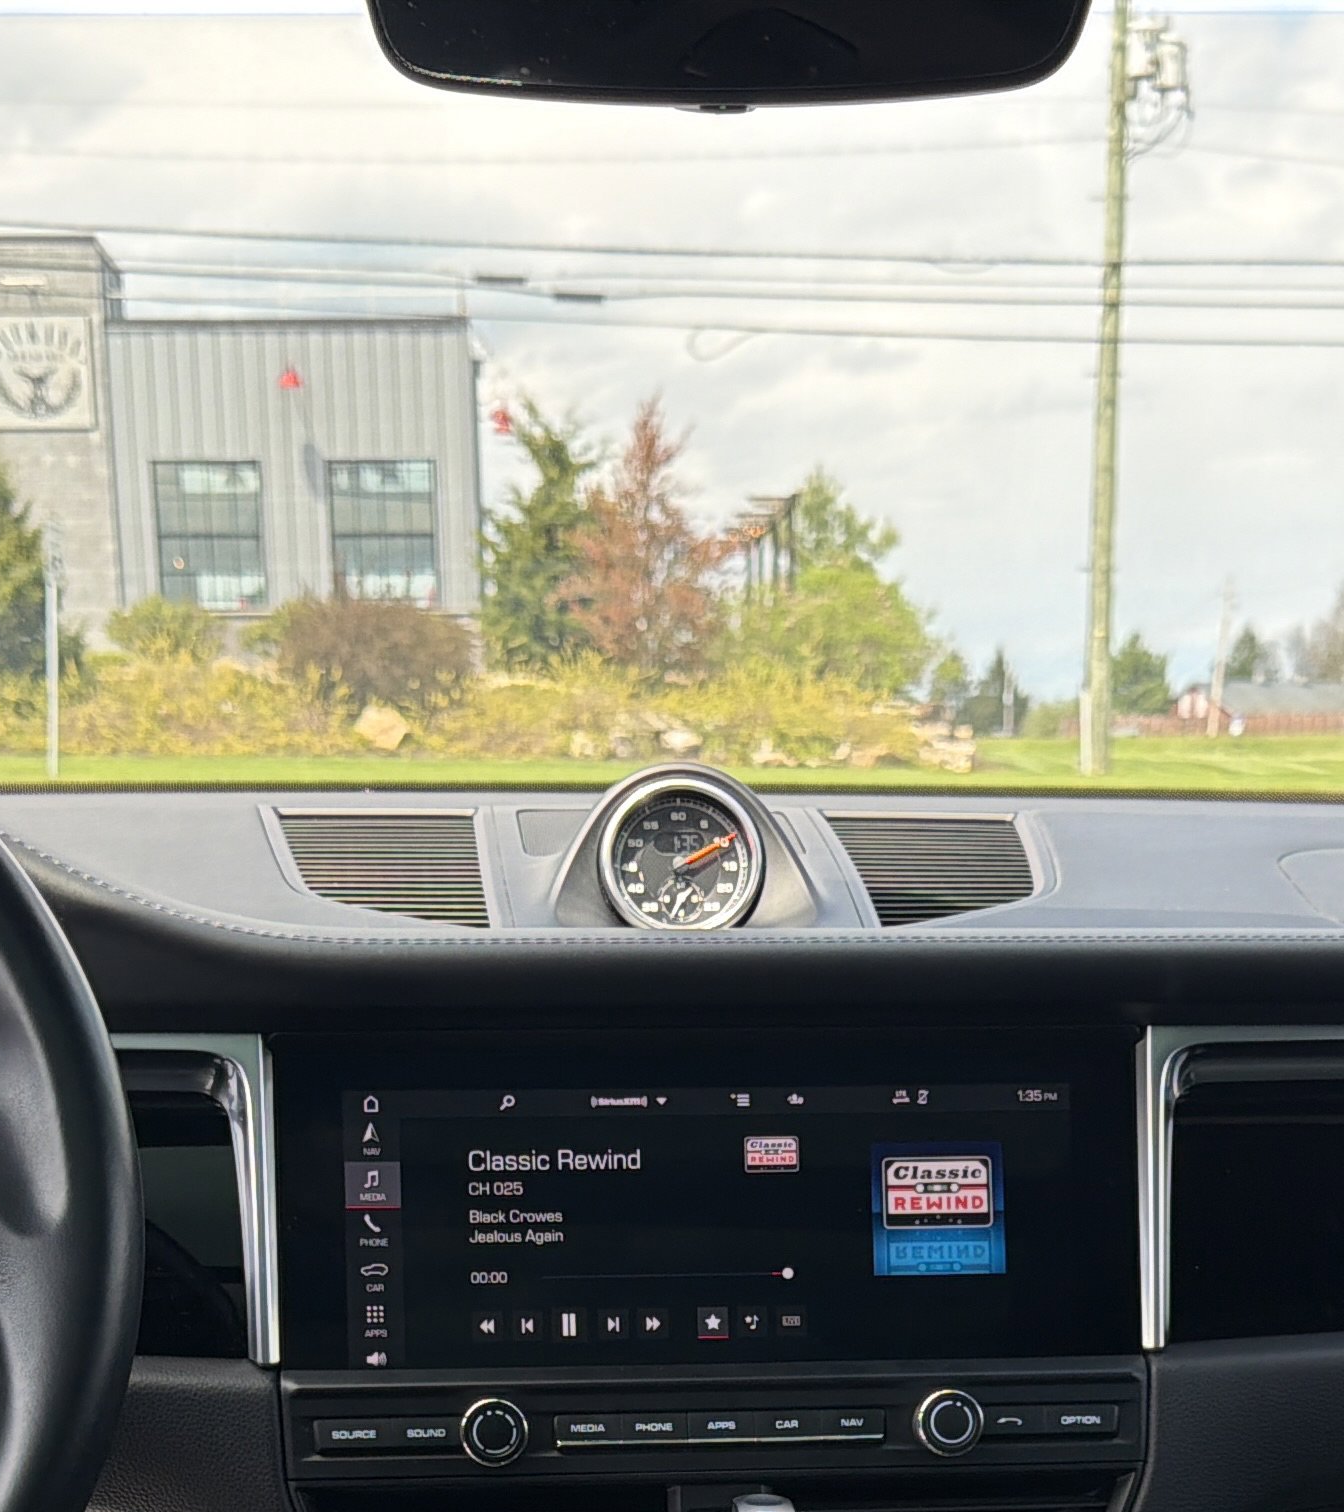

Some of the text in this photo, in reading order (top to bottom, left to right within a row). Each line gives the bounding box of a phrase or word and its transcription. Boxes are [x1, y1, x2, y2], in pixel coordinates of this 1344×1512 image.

[670, 812, 687, 821] 60
[627, 839, 644, 848] 50
[627, 883, 645, 894] 40
[1017, 1089, 1058, 1102] 1:35 PM
[750, 1140, 794, 1149] Classic
[362, 1147, 381, 1156] NAV
[468, 1148, 642, 1172] Classic Rewind
[750, 1155, 795, 1164] REWIND
[892, 1165, 983, 1181] Classic
[468, 1181, 524, 1196] CH 025
[359, 1192, 387, 1202] MEDIA
[893, 1195, 984, 1211] REWIND
[469, 1209, 563, 1224] Black Crowes
[359, 1237, 389, 1248] PHONE
[469, 1229, 564, 1245] Jealous Again
[470, 1271, 508, 1284] 00:00
[365, 1283, 385, 1293] CAR
[363, 1328, 388, 1339] APPS
[707, 1420, 737, 1430] APPS
[775, 1419, 799, 1430] CAR
[840, 1417, 864, 1428] NAV
[1060, 1414, 1102, 1426] OPTION
[570, 1422, 606, 1433] MEDIA
[634, 1421, 674, 1432] PHONE
[331, 1429, 377, 1440] SOURCE
[406, 1427, 447, 1438] SOUND
